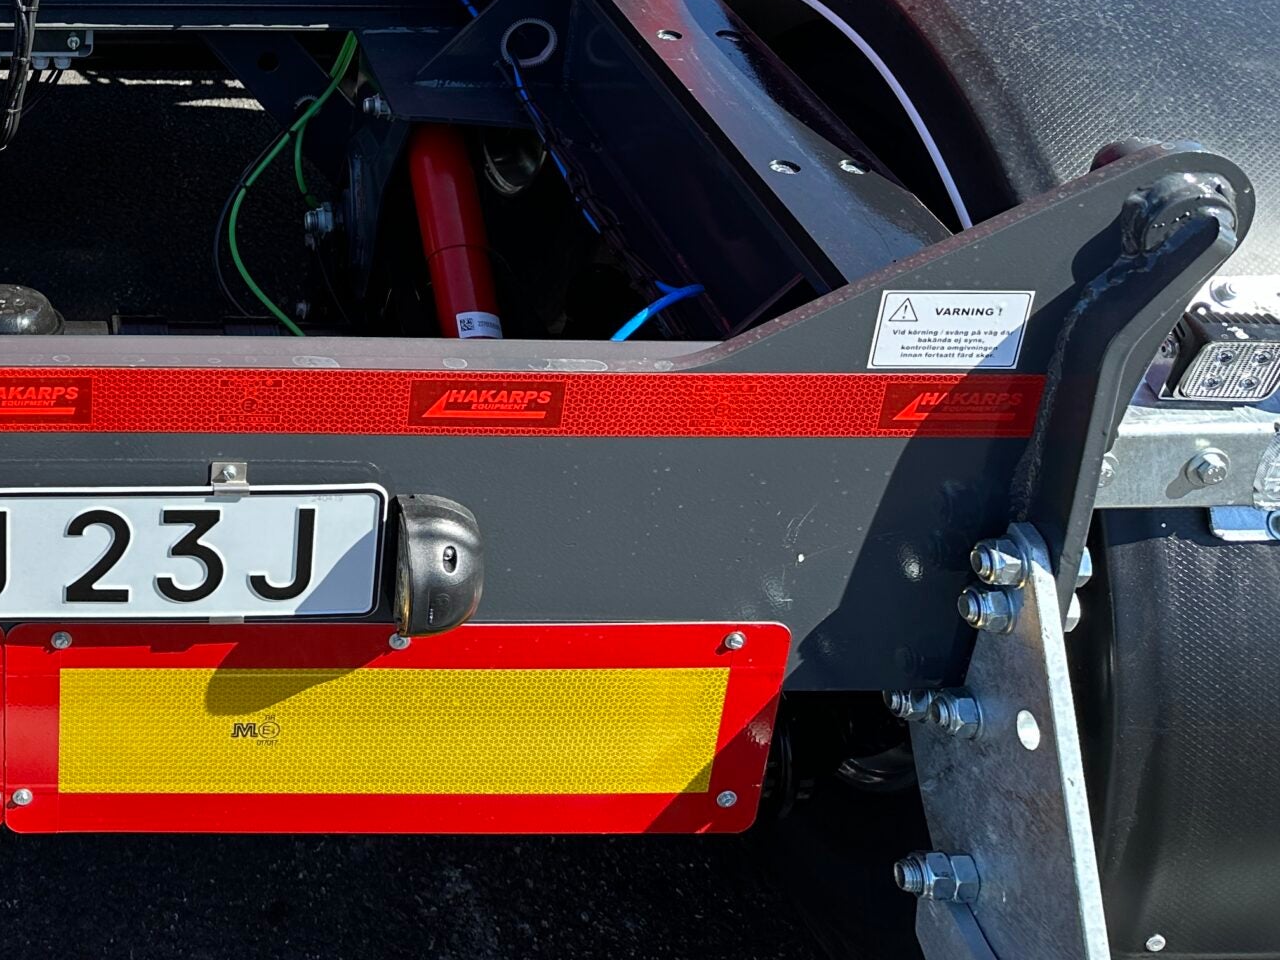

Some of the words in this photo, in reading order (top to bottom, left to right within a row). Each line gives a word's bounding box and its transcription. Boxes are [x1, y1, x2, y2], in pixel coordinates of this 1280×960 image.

[935, 307, 994, 316] VARNING
[892, 328, 906, 336] Vid
[971, 328, 982, 338] på
[983, 328, 999, 338] väg
[946, 344, 999, 353] omgivningen
[900, 351, 923, 359] innan
[923, 351, 955, 359] fortsatt
[956, 351, 974, 359] färd
[447, 389, 552, 404] HAKARPS
[920, 391, 1023, 405] HAKARPS
[64, 507, 315, 603] 23J
